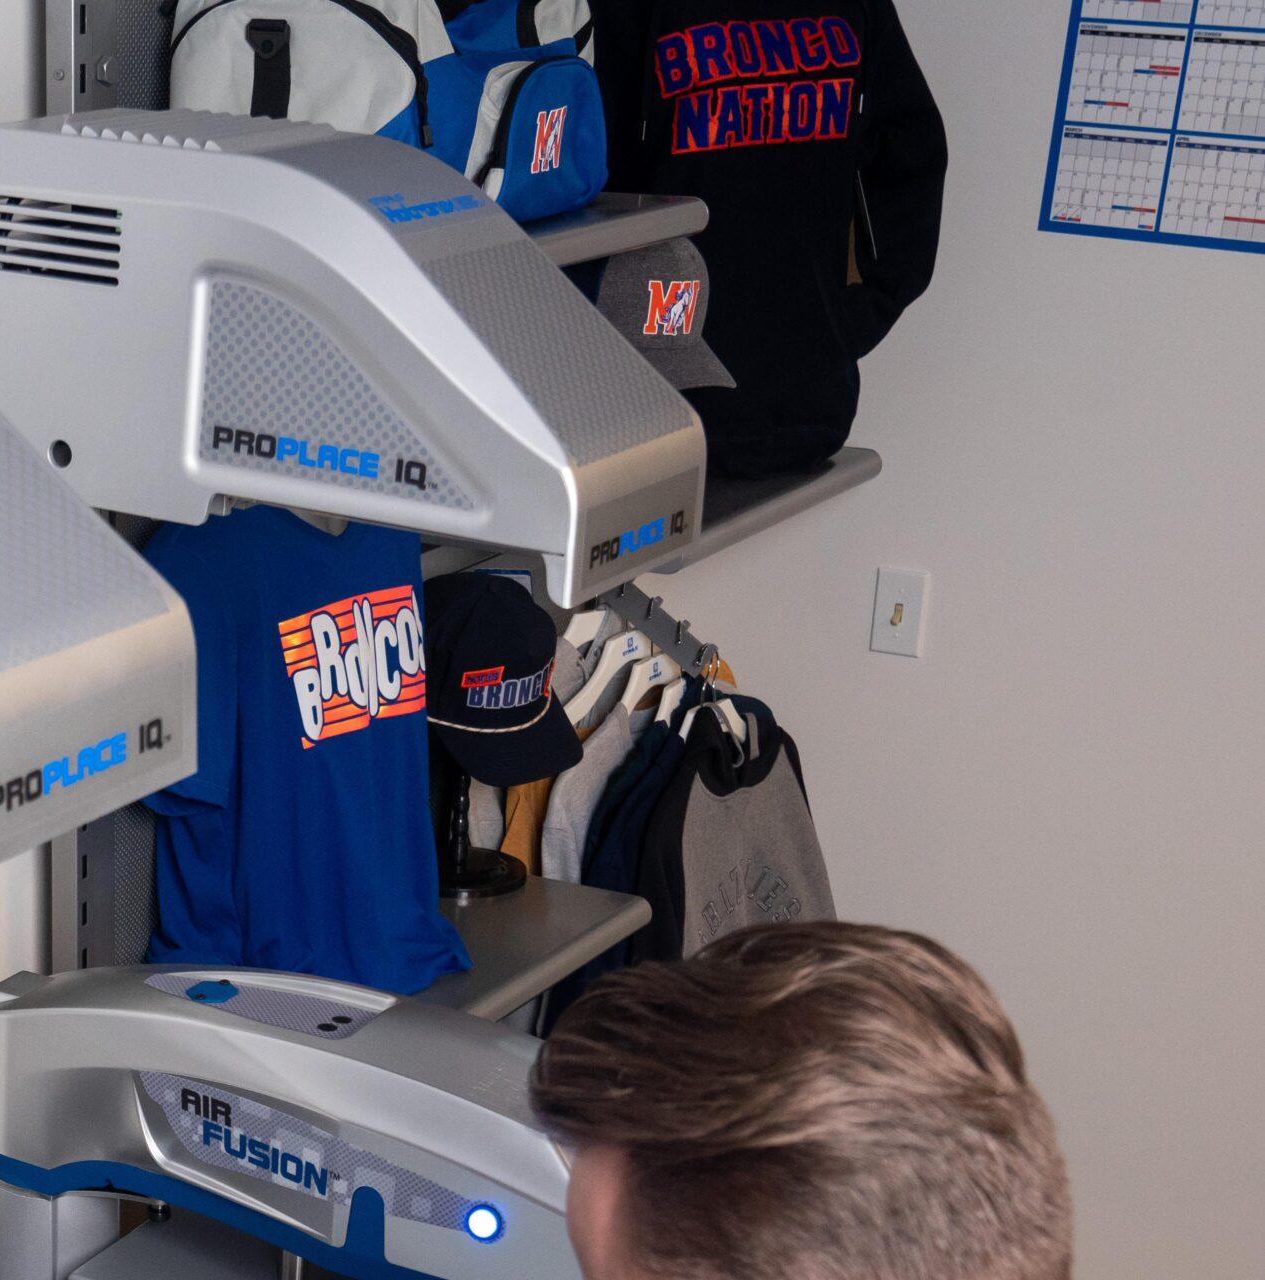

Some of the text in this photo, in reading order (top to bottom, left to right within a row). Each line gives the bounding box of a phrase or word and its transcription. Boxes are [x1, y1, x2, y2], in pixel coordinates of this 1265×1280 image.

[655, 16, 861, 98] BRONCO
[671, 78, 854, 154] NATION
[213, 426, 427, 490] PROPLACE IQ
[138, 718, 164, 754] IQ
[181, 1088, 232, 1127] AIR
[202, 1120, 328, 1196] FUSION
